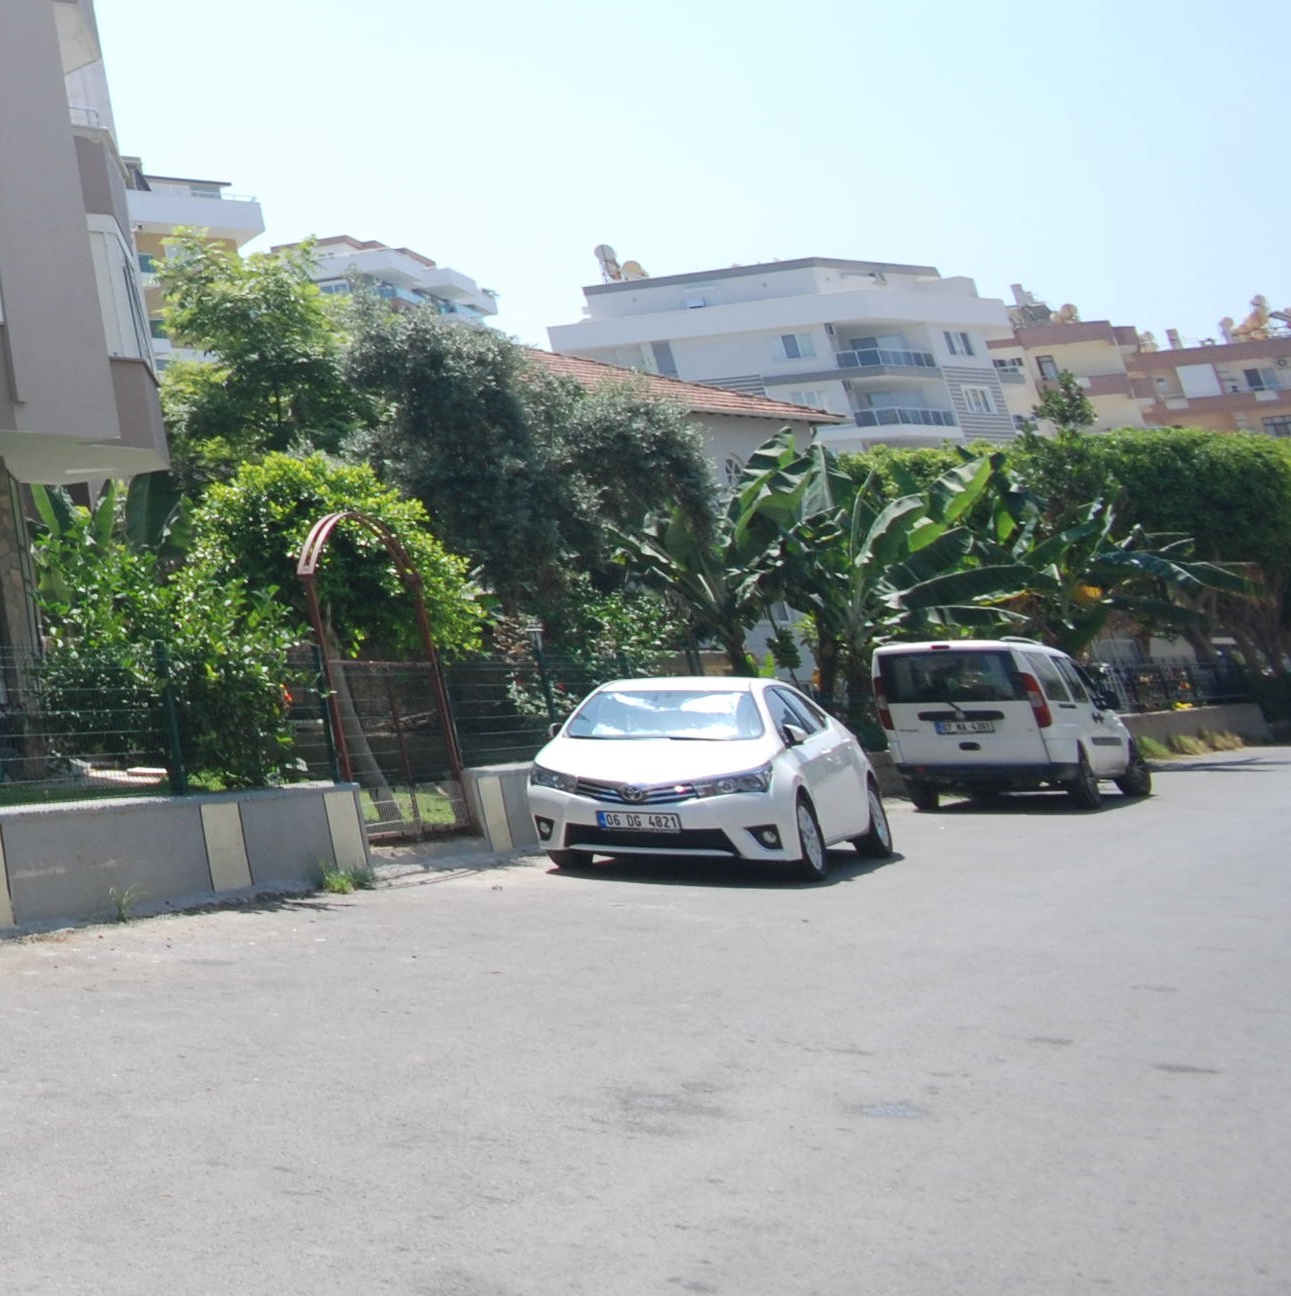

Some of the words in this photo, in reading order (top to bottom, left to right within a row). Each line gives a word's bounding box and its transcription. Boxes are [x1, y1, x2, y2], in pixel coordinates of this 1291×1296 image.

[606, 814, 620, 826] 06
[626, 814, 642, 827] DG
[648, 815, 677, 829] 4821
